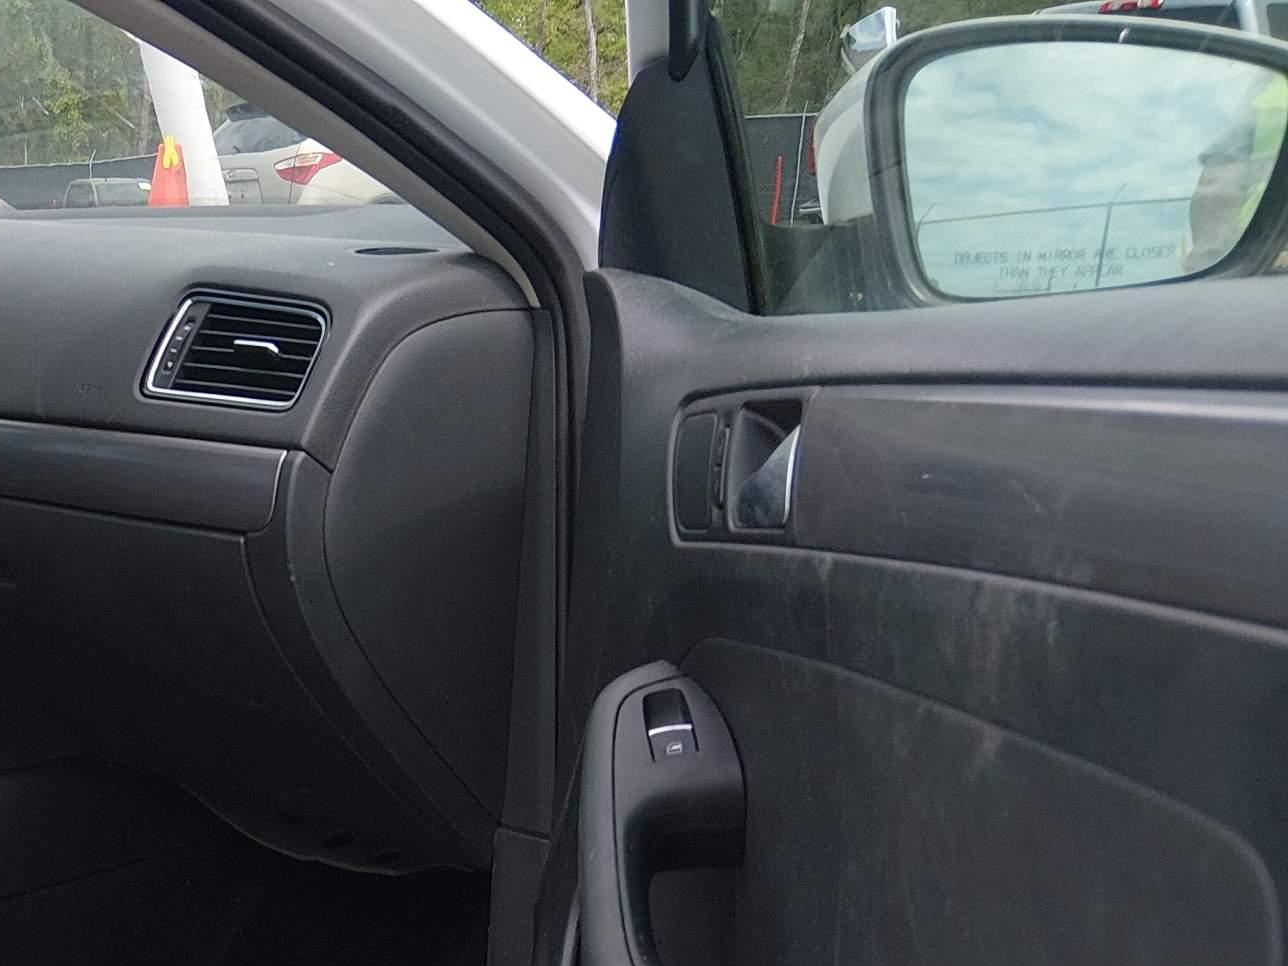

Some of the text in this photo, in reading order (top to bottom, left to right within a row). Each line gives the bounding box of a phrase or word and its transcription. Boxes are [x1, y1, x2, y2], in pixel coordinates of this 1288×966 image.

[953, 250, 1009, 265] OBJECTS
[1016, 249, 1032, 263] IN
[1038, 247, 1086, 262] MIRROR
[1125, 244, 1177, 259] CLOSER
[998, 265, 1030, 279] THAN
[1037, 264, 1068, 277] THEY
